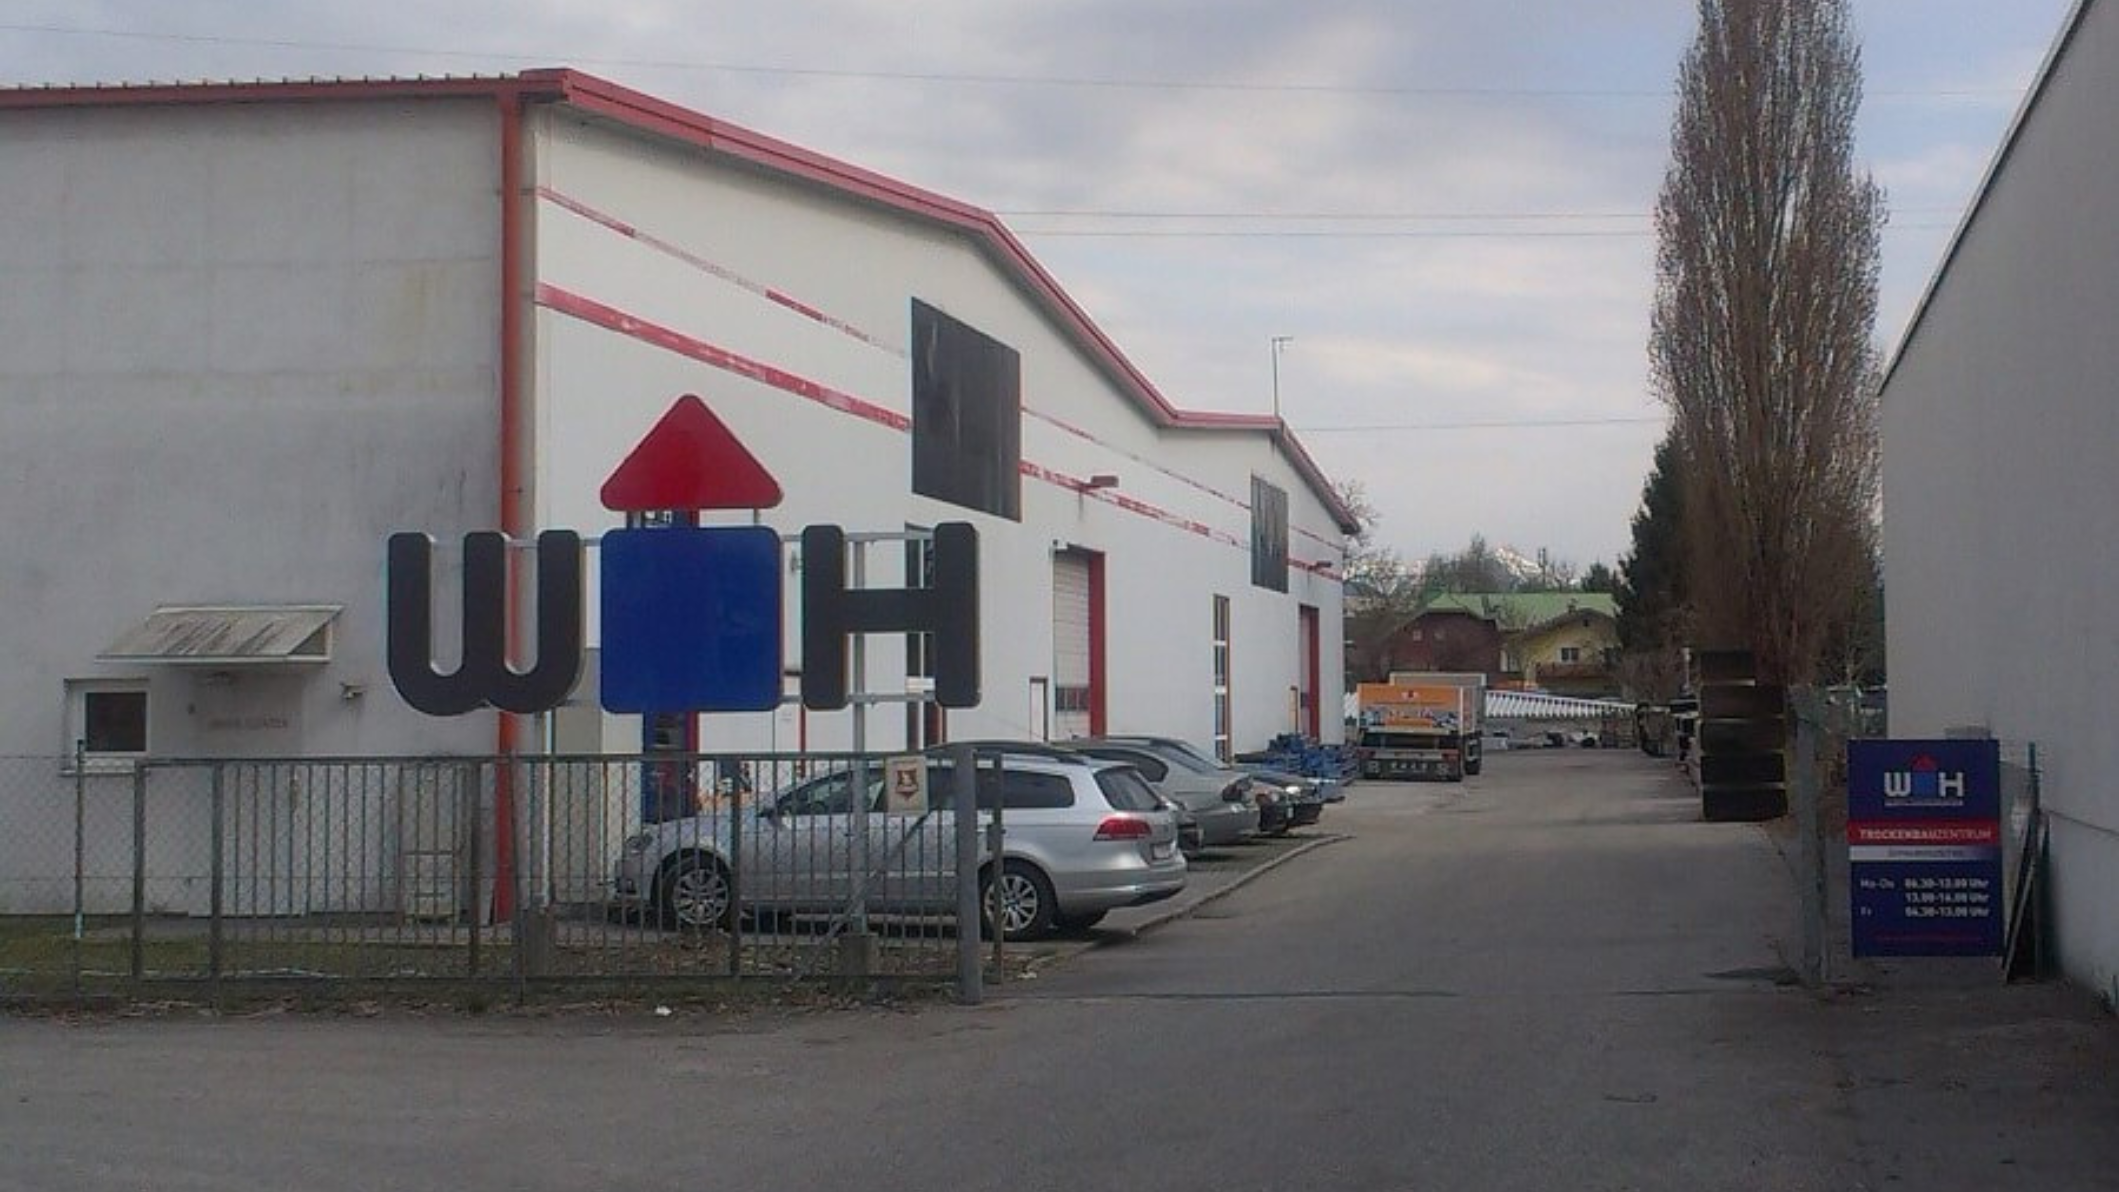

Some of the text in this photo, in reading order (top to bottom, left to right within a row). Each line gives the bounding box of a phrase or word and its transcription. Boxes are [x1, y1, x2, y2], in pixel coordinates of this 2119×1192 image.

[1859, 828, 1992, 840] TROCKENBAUZENTRUM
[1969, 877, 1989, 889] Uhr
[1969, 891, 1989, 903] Uhr
[1969, 905, 1989, 917] Uhr
